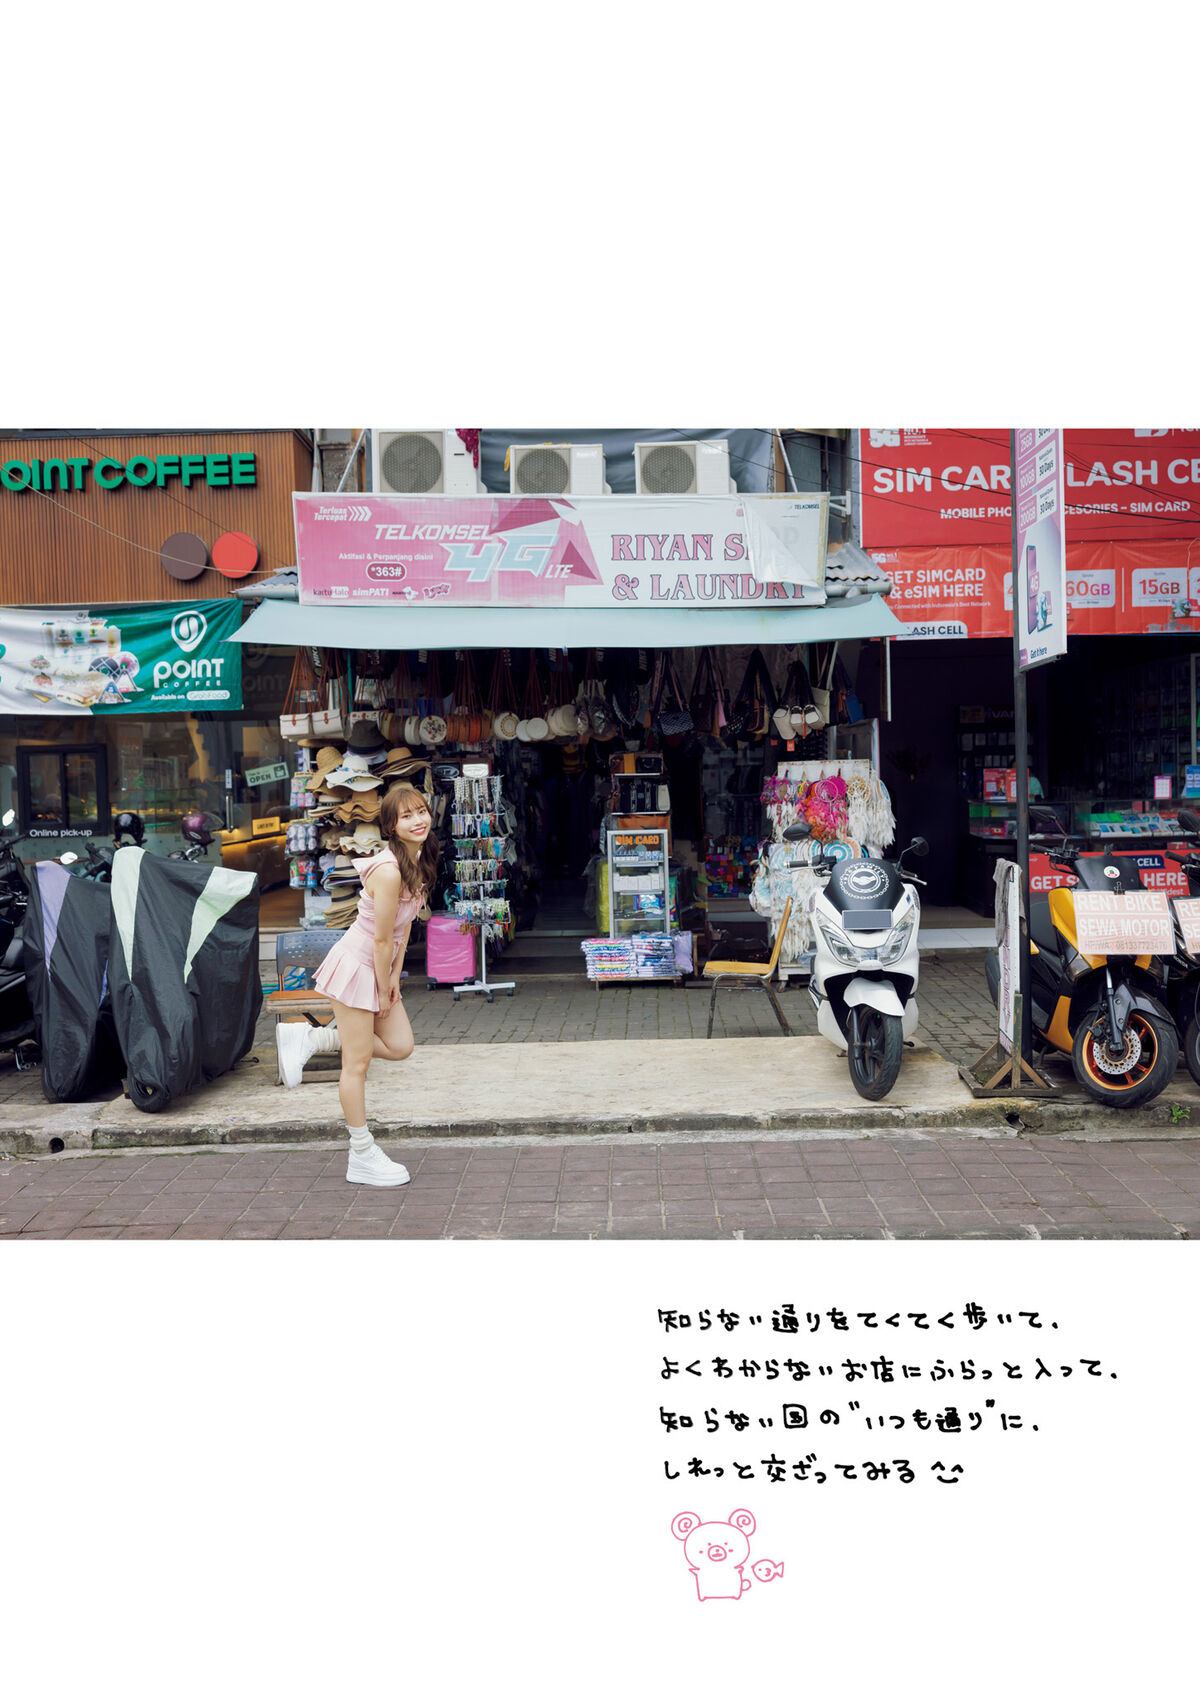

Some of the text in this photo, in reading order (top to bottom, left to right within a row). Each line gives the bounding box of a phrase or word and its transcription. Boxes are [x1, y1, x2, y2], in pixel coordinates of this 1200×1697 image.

[94, 453, 257, 490] COFFEE
[1067, 460, 1158, 487] LASH
[873, 467, 932, 493] SIM
[940, 507, 985, 519] MOBILE
[1130, 502, 1152, 513] SIM
[1155, 501, 1191, 512] CARD
[374, 524, 493, 540] TELKOMSEL
[611, 534, 713, 561] RIYAN
[373, 553, 413, 561] Perpanjang
[414, 552, 433, 560] disini
[439, 532, 560, 582] 4G
[544, 564, 573, 579] LTE
[917, 568, 986, 582] SIMCARD
[611, 574, 639, 600] &
[889, 584, 984, 599] & eSIM HERE
[1066, 580, 1111, 597] 60GB
[1139, 579, 1180, 595] 15GB
[938, 625, 963, 635] CELL
[153, 658, 224, 688] POINT
[163, 680, 221, 688] COFFEE
[249, 773, 271, 783] OPEN
[29, 828, 93, 838] Online pick-up
[635, 835, 660, 845] CARD
[1137, 858, 1160, 867] CELL
[1031, 875, 1063, 890] GET
[1143, 873, 1187, 887] HERE
[1078, 894, 1164, 912] RENT BIKE
[1079, 919, 1170, 937] SEWA MOTOR
